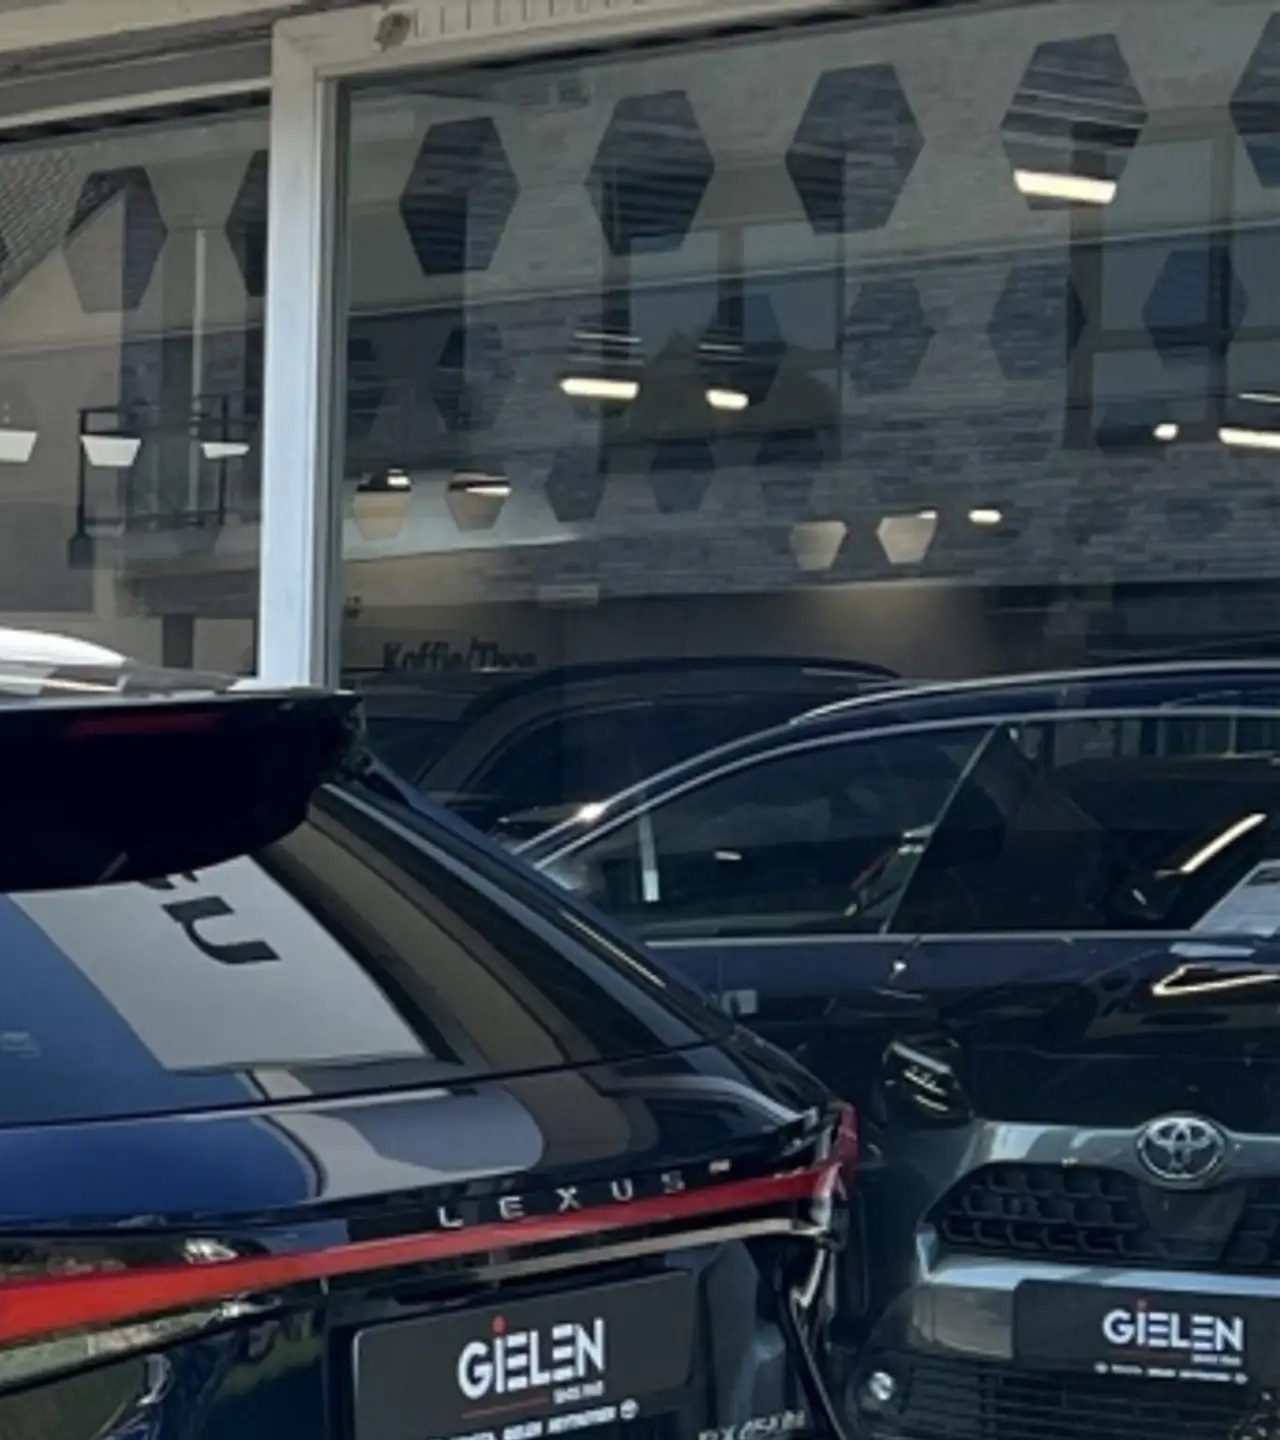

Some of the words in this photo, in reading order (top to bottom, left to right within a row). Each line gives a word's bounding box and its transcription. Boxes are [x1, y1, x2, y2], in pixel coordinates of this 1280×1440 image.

[437, 1170, 686, 1229] LEXUS
[1103, 1300, 1244, 1352] GIELEN
[457, 1316, 605, 1400] GIELEN
